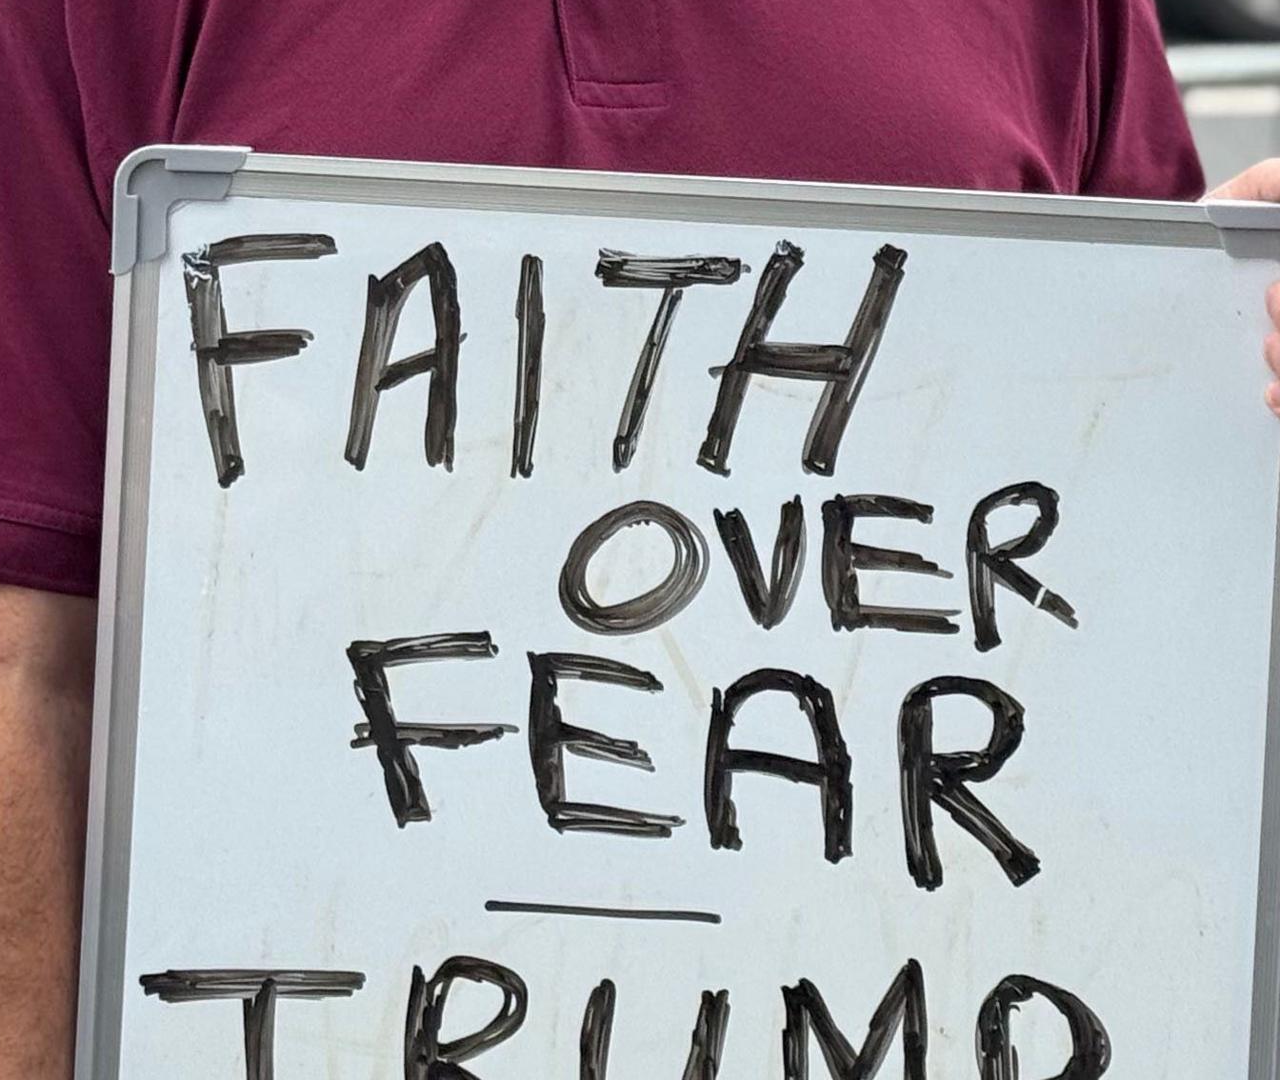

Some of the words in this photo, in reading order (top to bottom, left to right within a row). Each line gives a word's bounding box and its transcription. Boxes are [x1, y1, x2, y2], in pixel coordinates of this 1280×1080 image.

[181, 233, 908, 489] FAITH
[558, 480, 1080, 653] OVER
[345, 630, 1042, 893] FEAR
